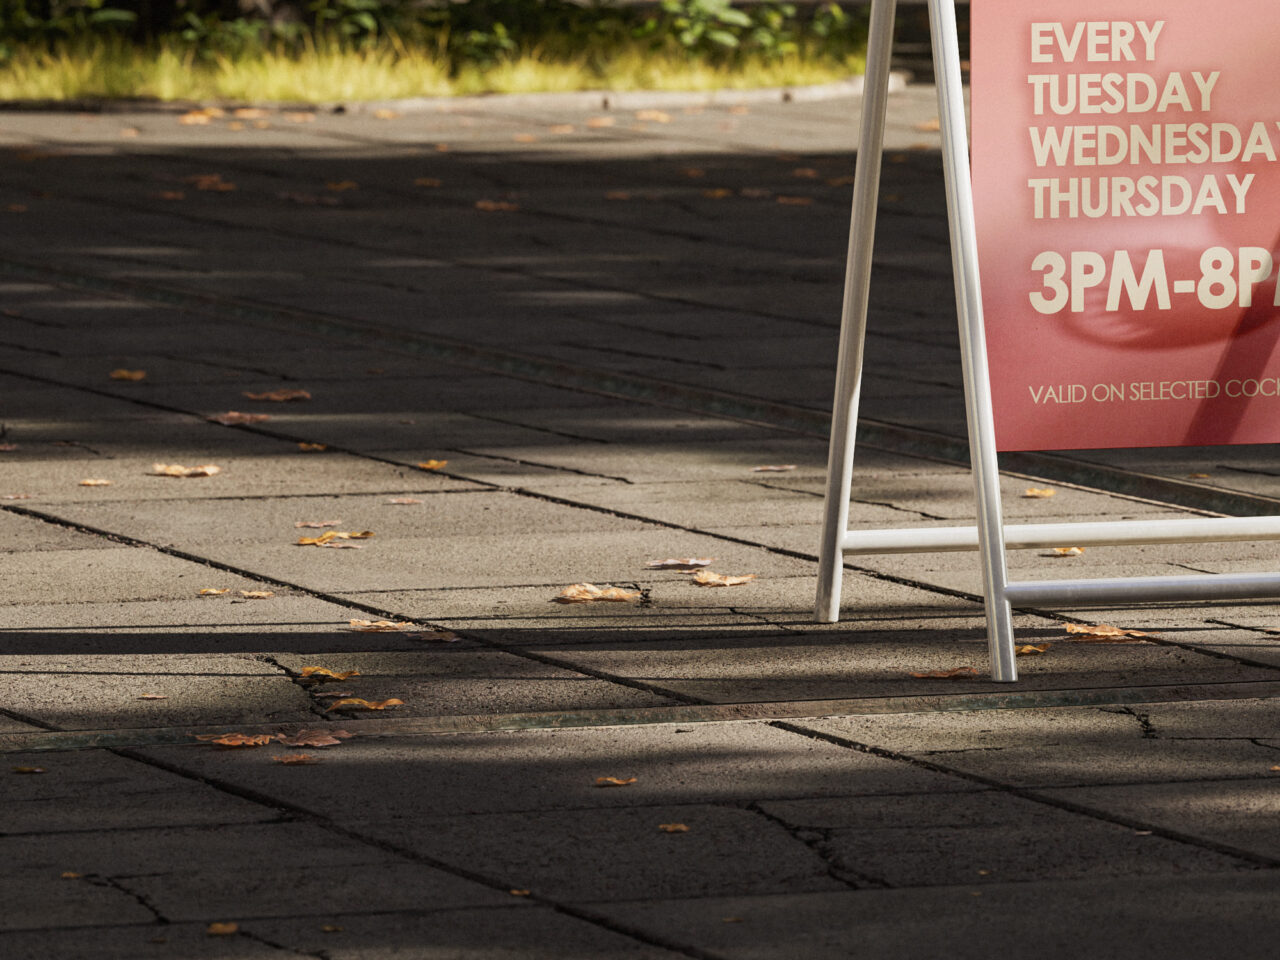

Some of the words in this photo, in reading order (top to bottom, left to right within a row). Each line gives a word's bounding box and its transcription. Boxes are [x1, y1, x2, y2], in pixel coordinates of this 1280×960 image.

[1030, 20, 1165, 62] EVERY
[1027, 71, 1221, 115] TUESDAY
[1027, 173, 1256, 219] THURSDAY
[1028, 384, 1087, 403] VALID
[1091, 383, 1126, 402] ON
[1129, 380, 1220, 400] SELECTED
